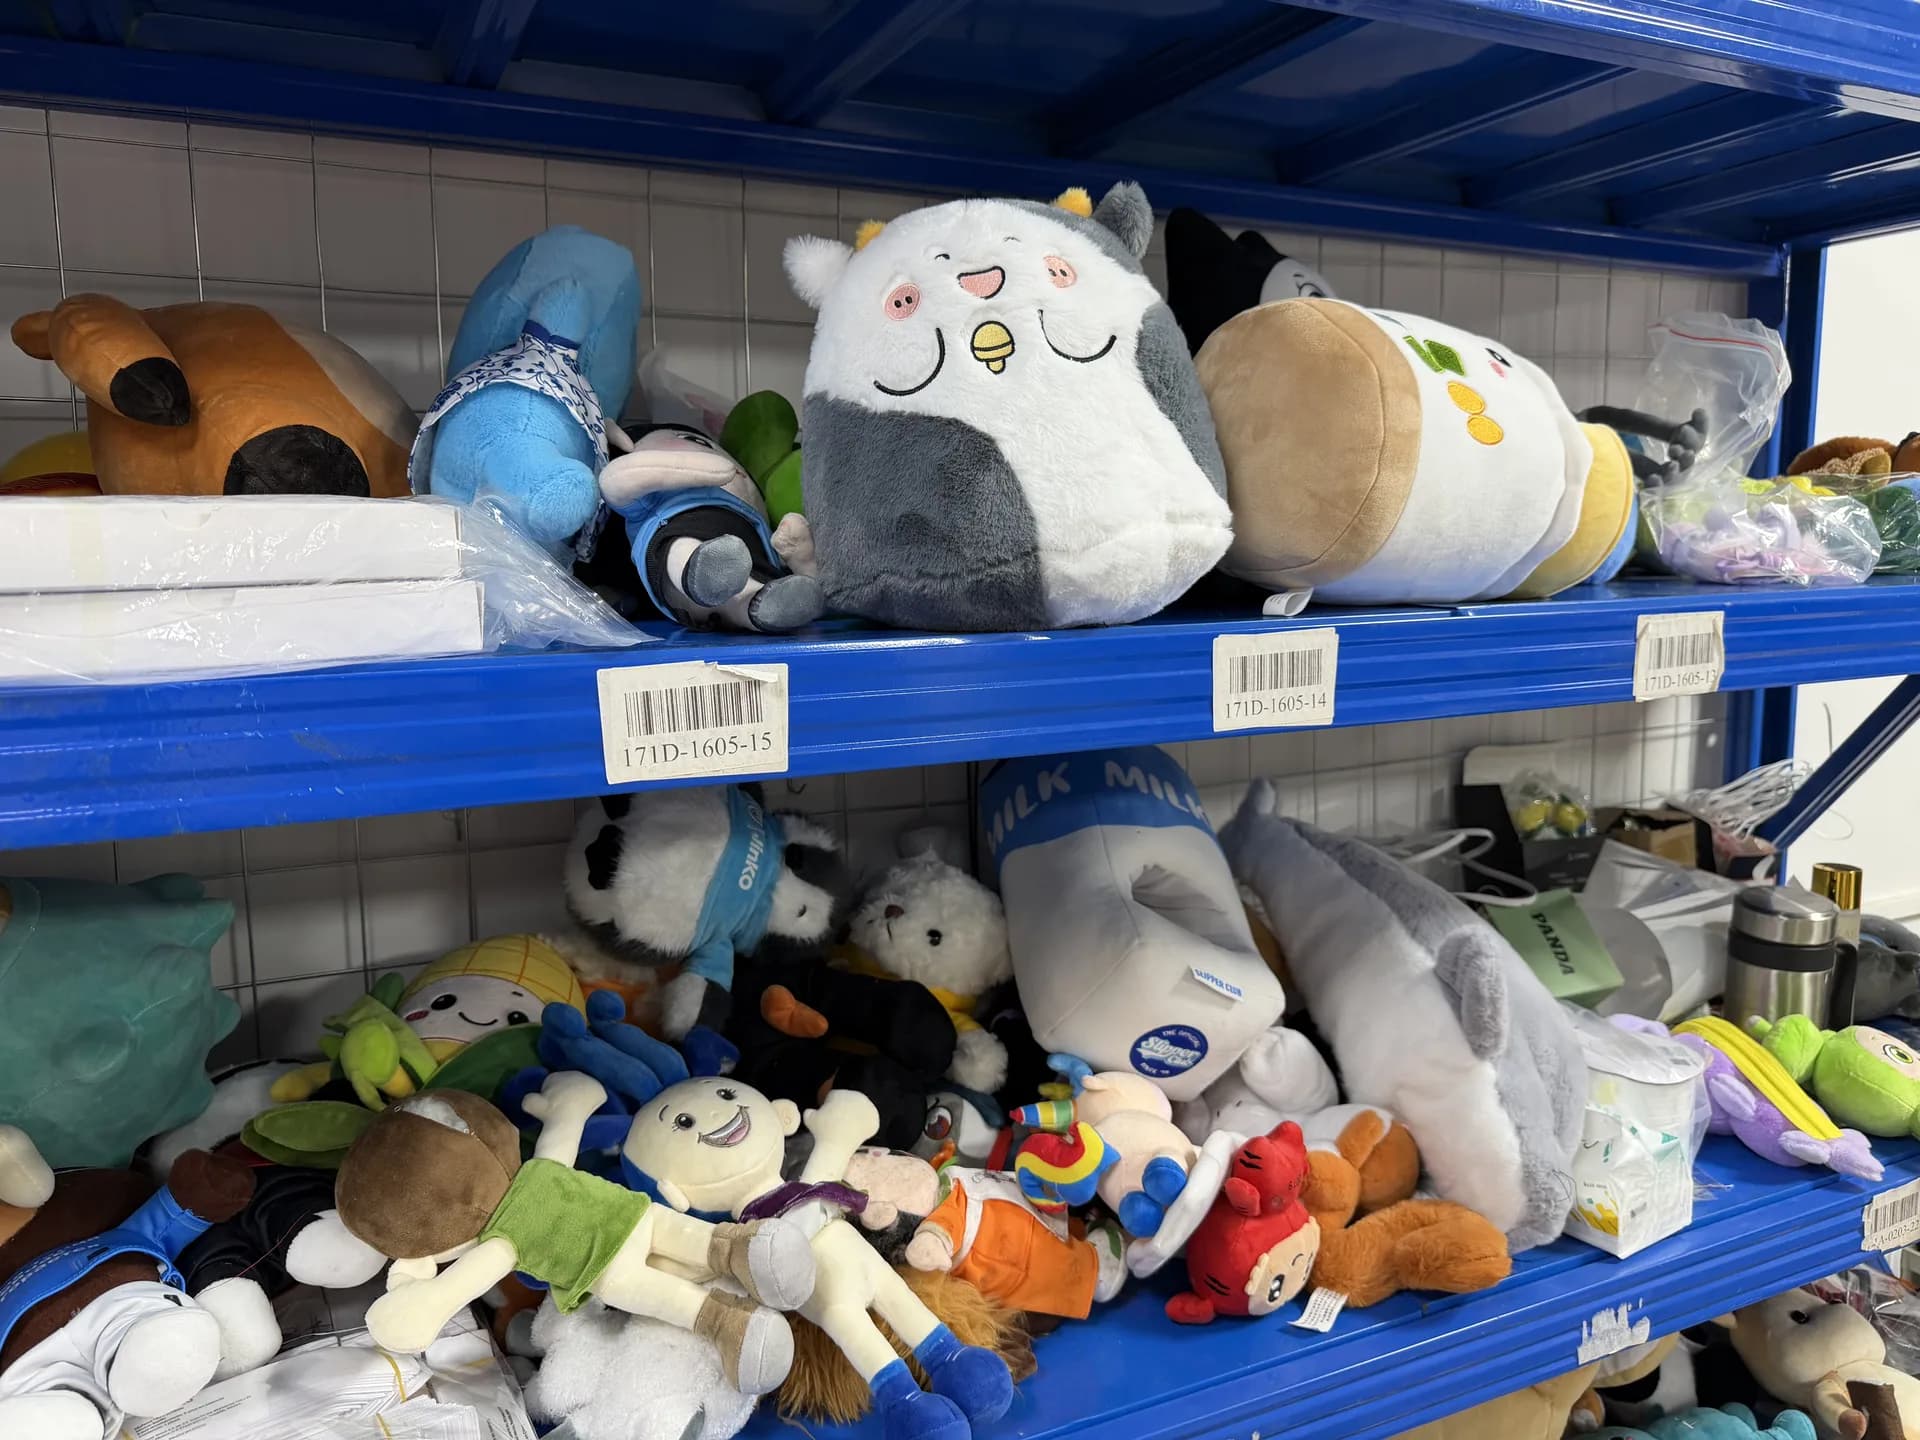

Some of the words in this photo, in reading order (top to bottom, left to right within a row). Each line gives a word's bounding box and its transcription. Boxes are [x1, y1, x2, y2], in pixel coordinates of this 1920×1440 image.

[1225, 692, 1327, 719] 171D-1605-14
[624, 731, 772, 767] 171D-1605-15
[1531, 912, 1576, 976] PANDA
